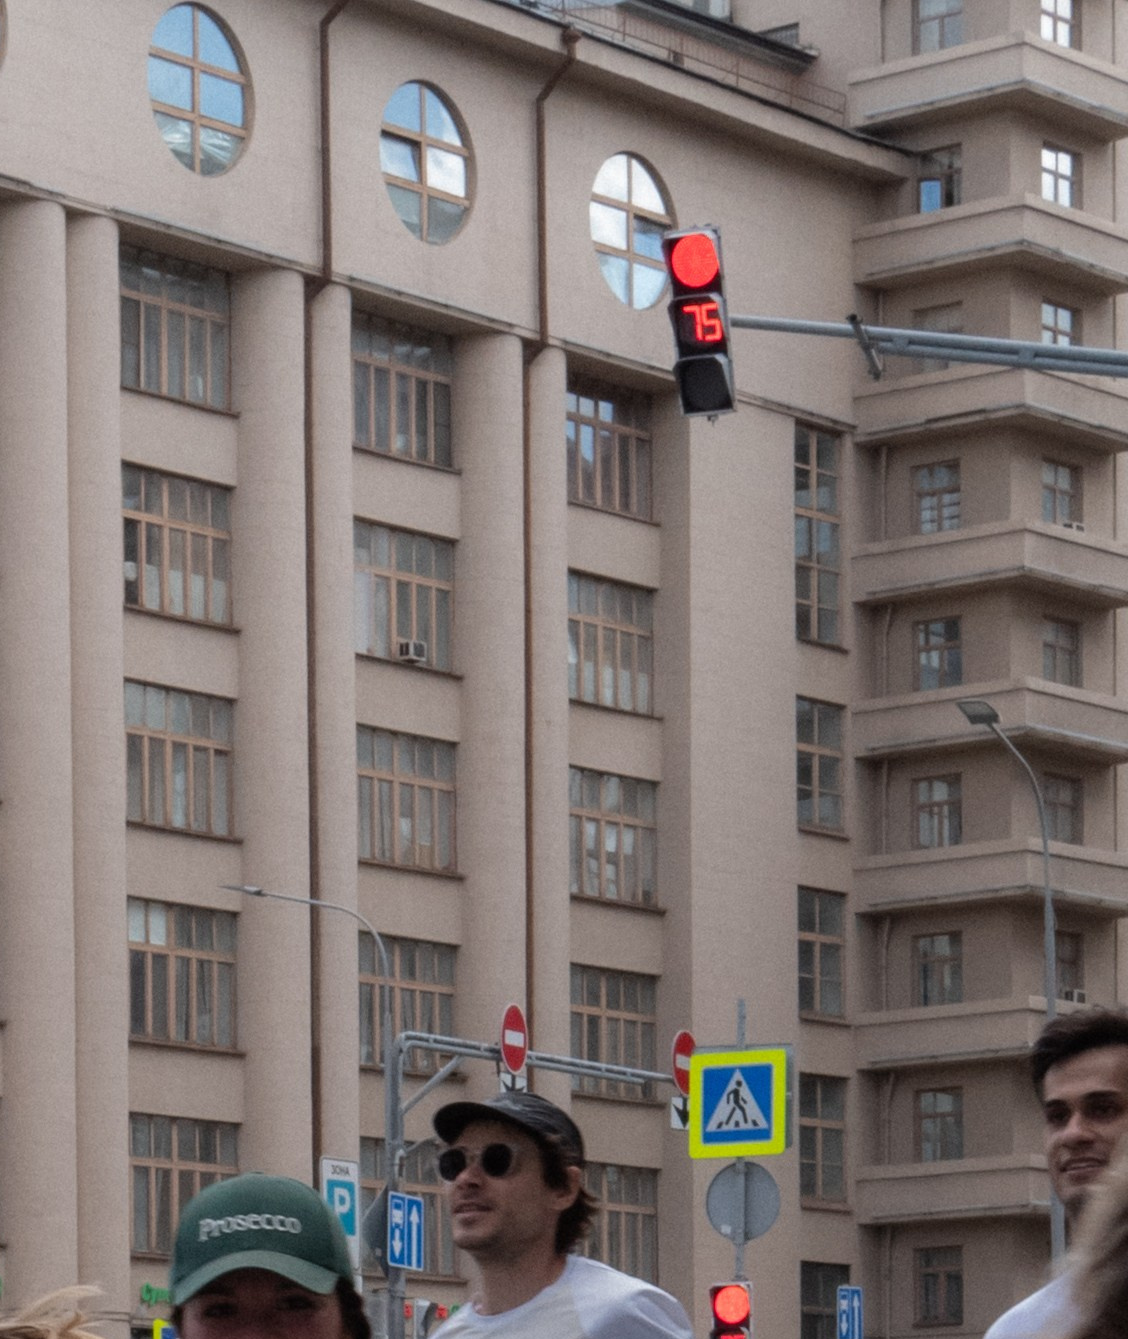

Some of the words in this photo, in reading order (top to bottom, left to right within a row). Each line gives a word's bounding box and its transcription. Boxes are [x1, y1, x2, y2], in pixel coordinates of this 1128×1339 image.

[682, 302, 723, 341] 75
[334, 1187, 351, 1214] P
[198, 1213, 302, 1242] Prosecco
